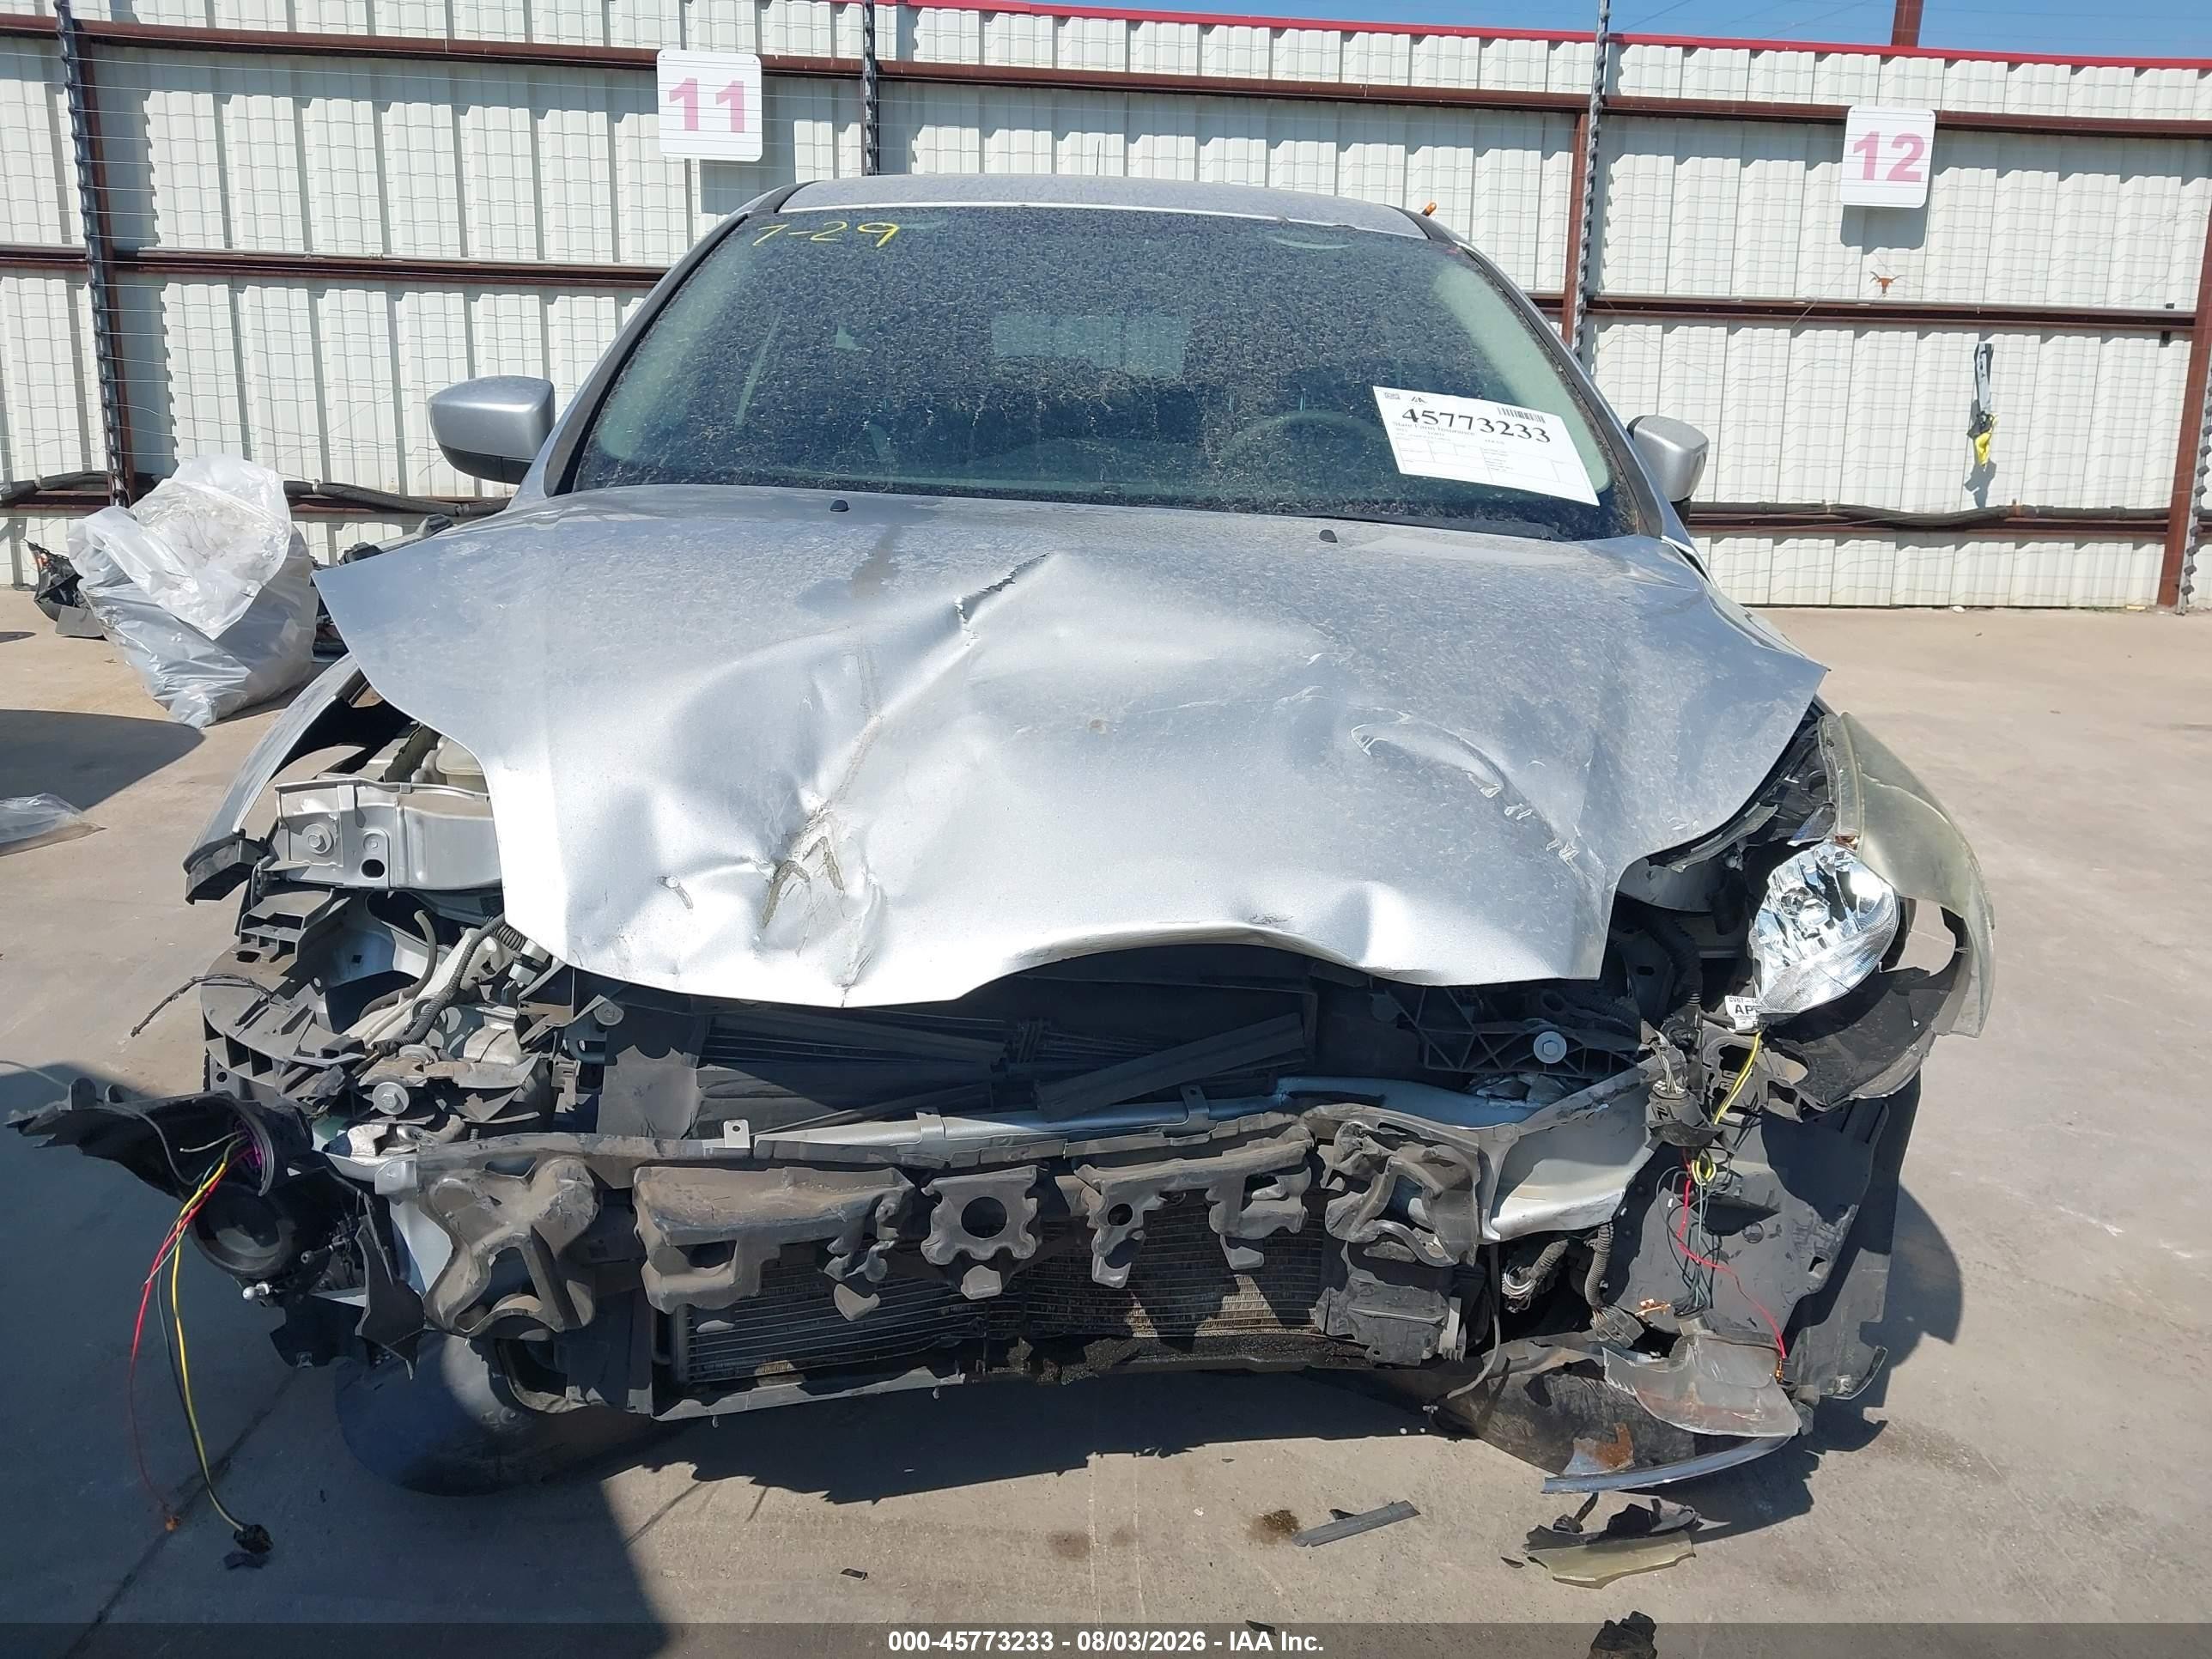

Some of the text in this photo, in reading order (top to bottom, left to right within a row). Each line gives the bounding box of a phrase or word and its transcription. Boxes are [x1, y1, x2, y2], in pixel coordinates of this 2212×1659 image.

[669, 76, 745, 133] 11
[1853, 131, 1925, 182] 12
[1401, 408, 1551, 443] 45773233
